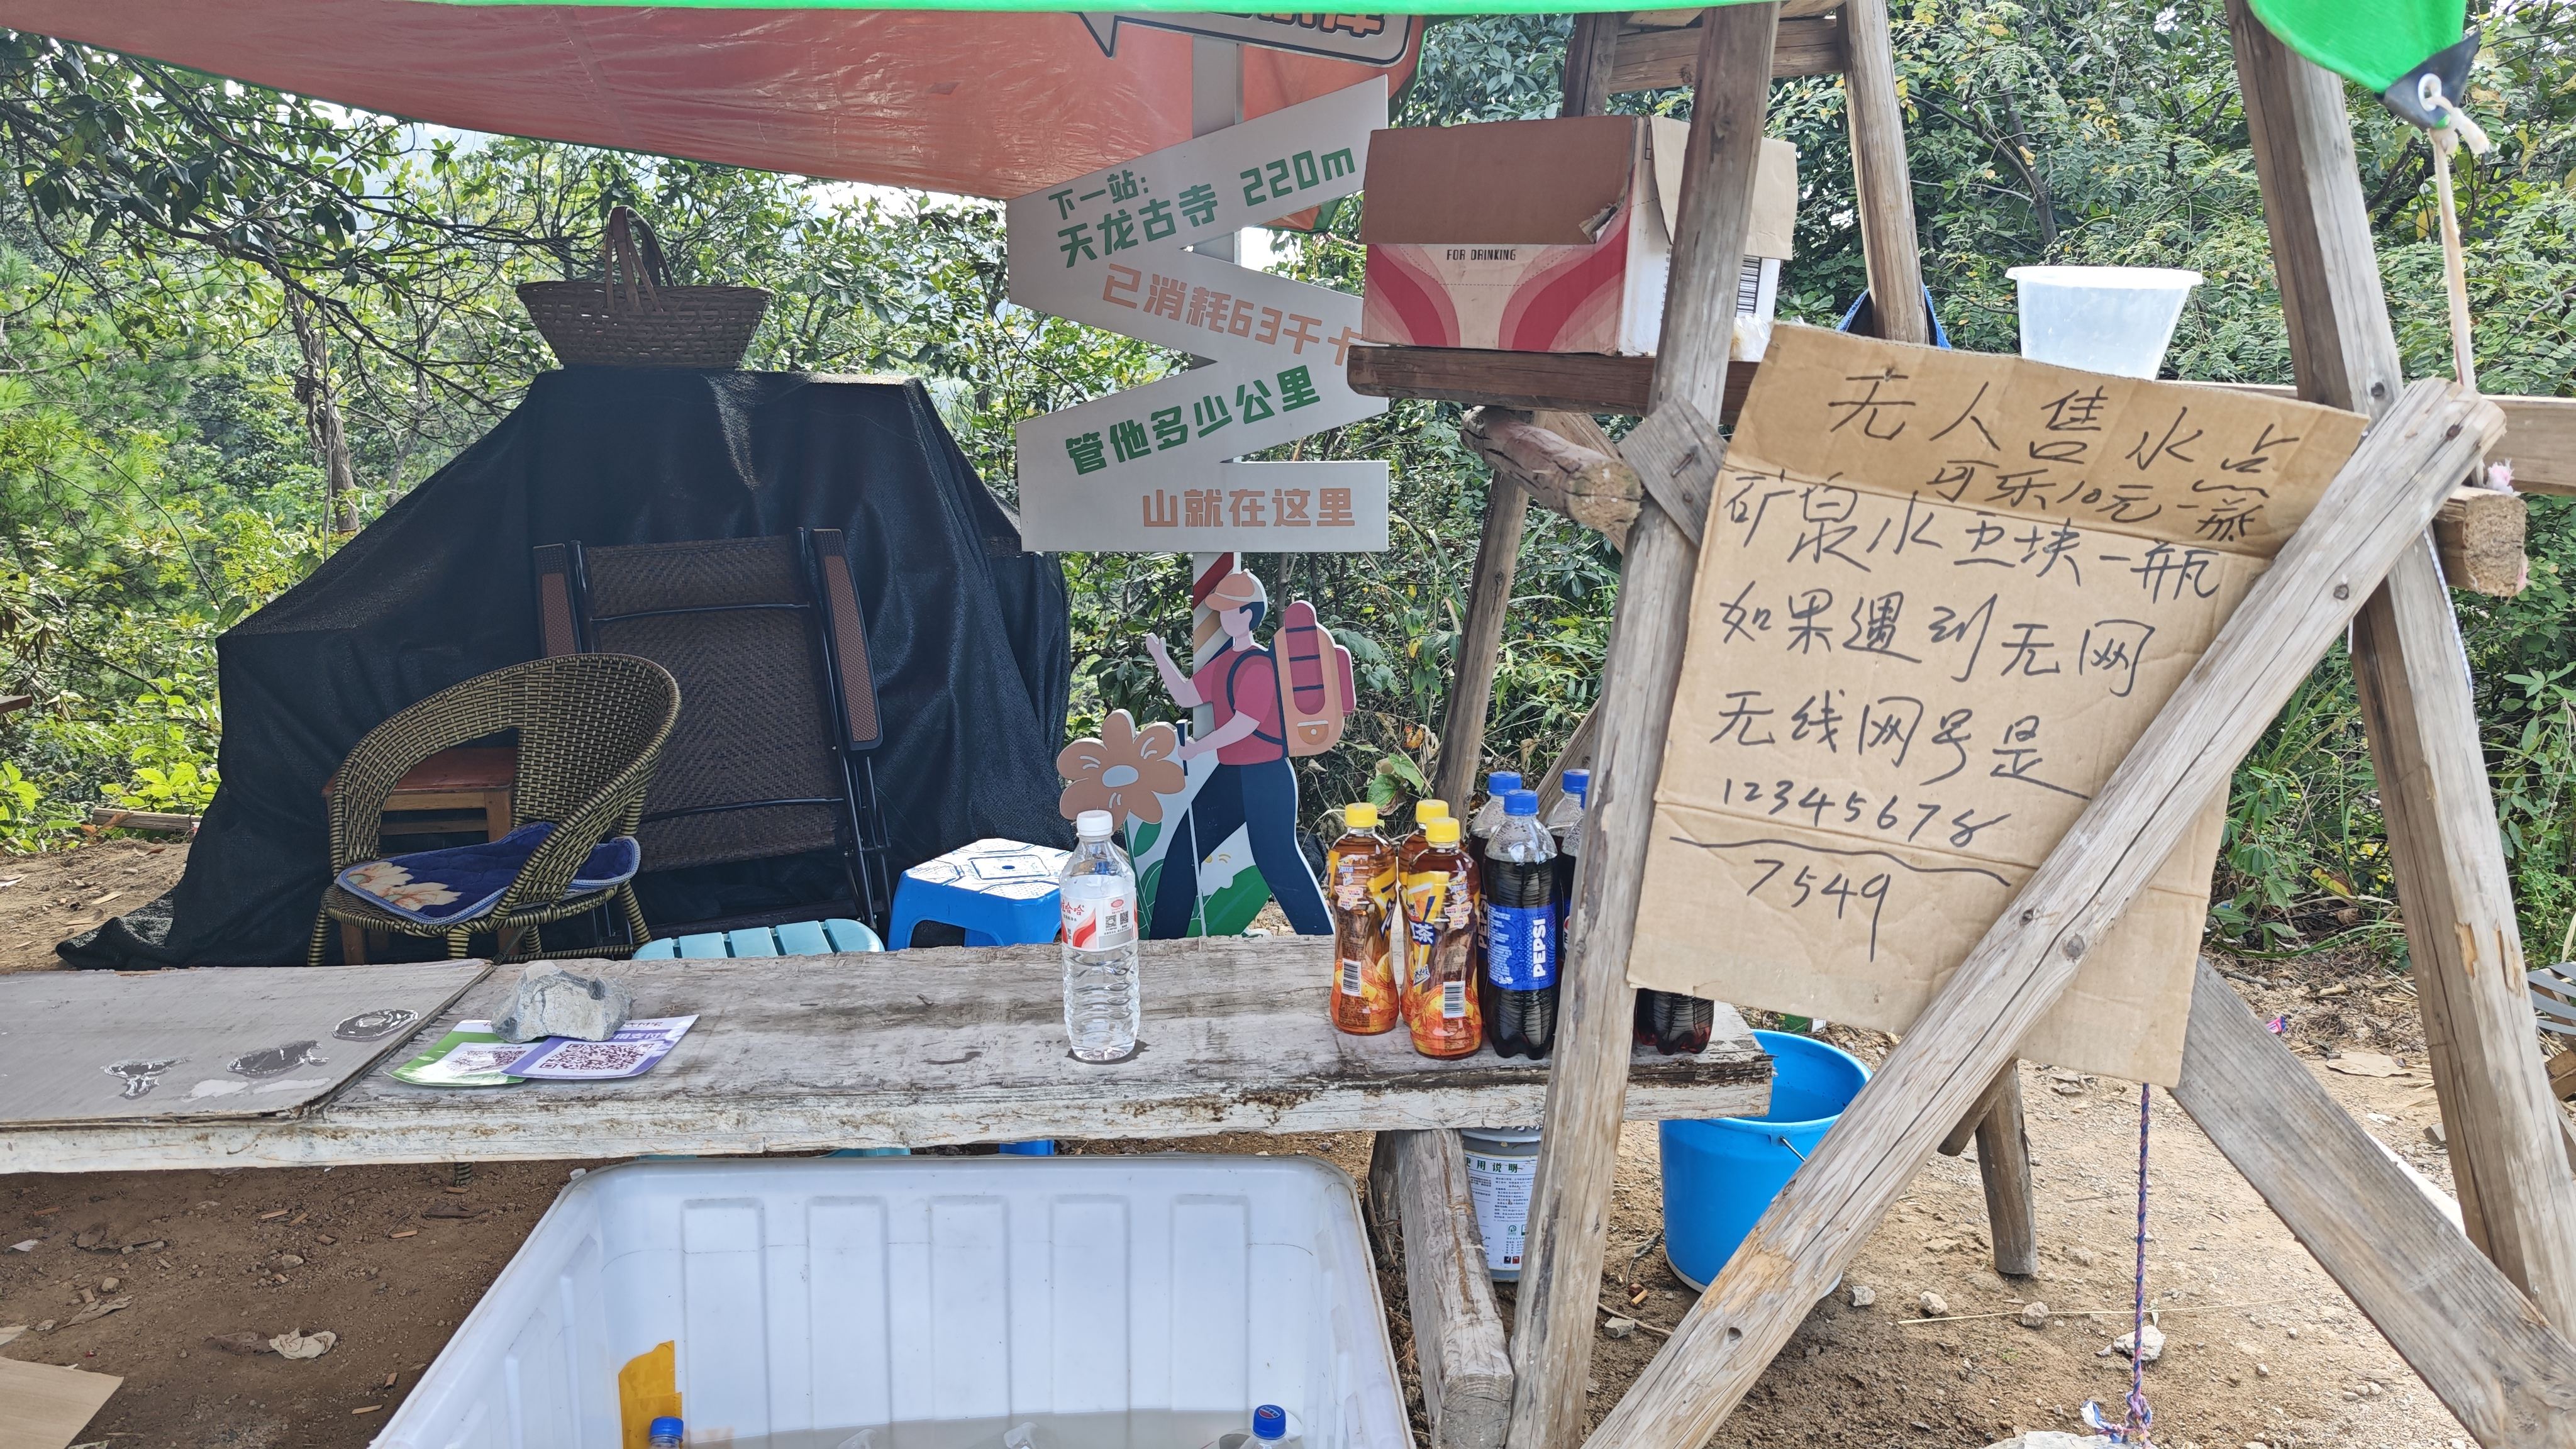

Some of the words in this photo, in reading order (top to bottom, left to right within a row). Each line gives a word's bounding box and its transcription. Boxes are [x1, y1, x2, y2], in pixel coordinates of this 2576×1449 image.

[1048, 170, 1149, 220] 下一站:
[1058, 184, 1218, 268] 天龙古寺
[1240, 148, 1355, 206] 220m
[1446, 249, 1465, 260] FOR
[1470, 249, 1516, 260] DRINKING
[1065, 365, 1320, 475] 管他多少公里
[1828, 373, 2299, 497] 无人售水点
[1142, 488, 1355, 528] 山就在这里
[1723, 468, 2219, 602] 矿泉水五块一瓶
[1719, 580, 2156, 697] 如果遇到无网
[1709, 690, 2092, 799] 无线网号是
[1723, 778, 2011, 848] 12345678
[1533, 918, 1546, 978] PEPSI
[1747, 858, 1891, 962] 7549
